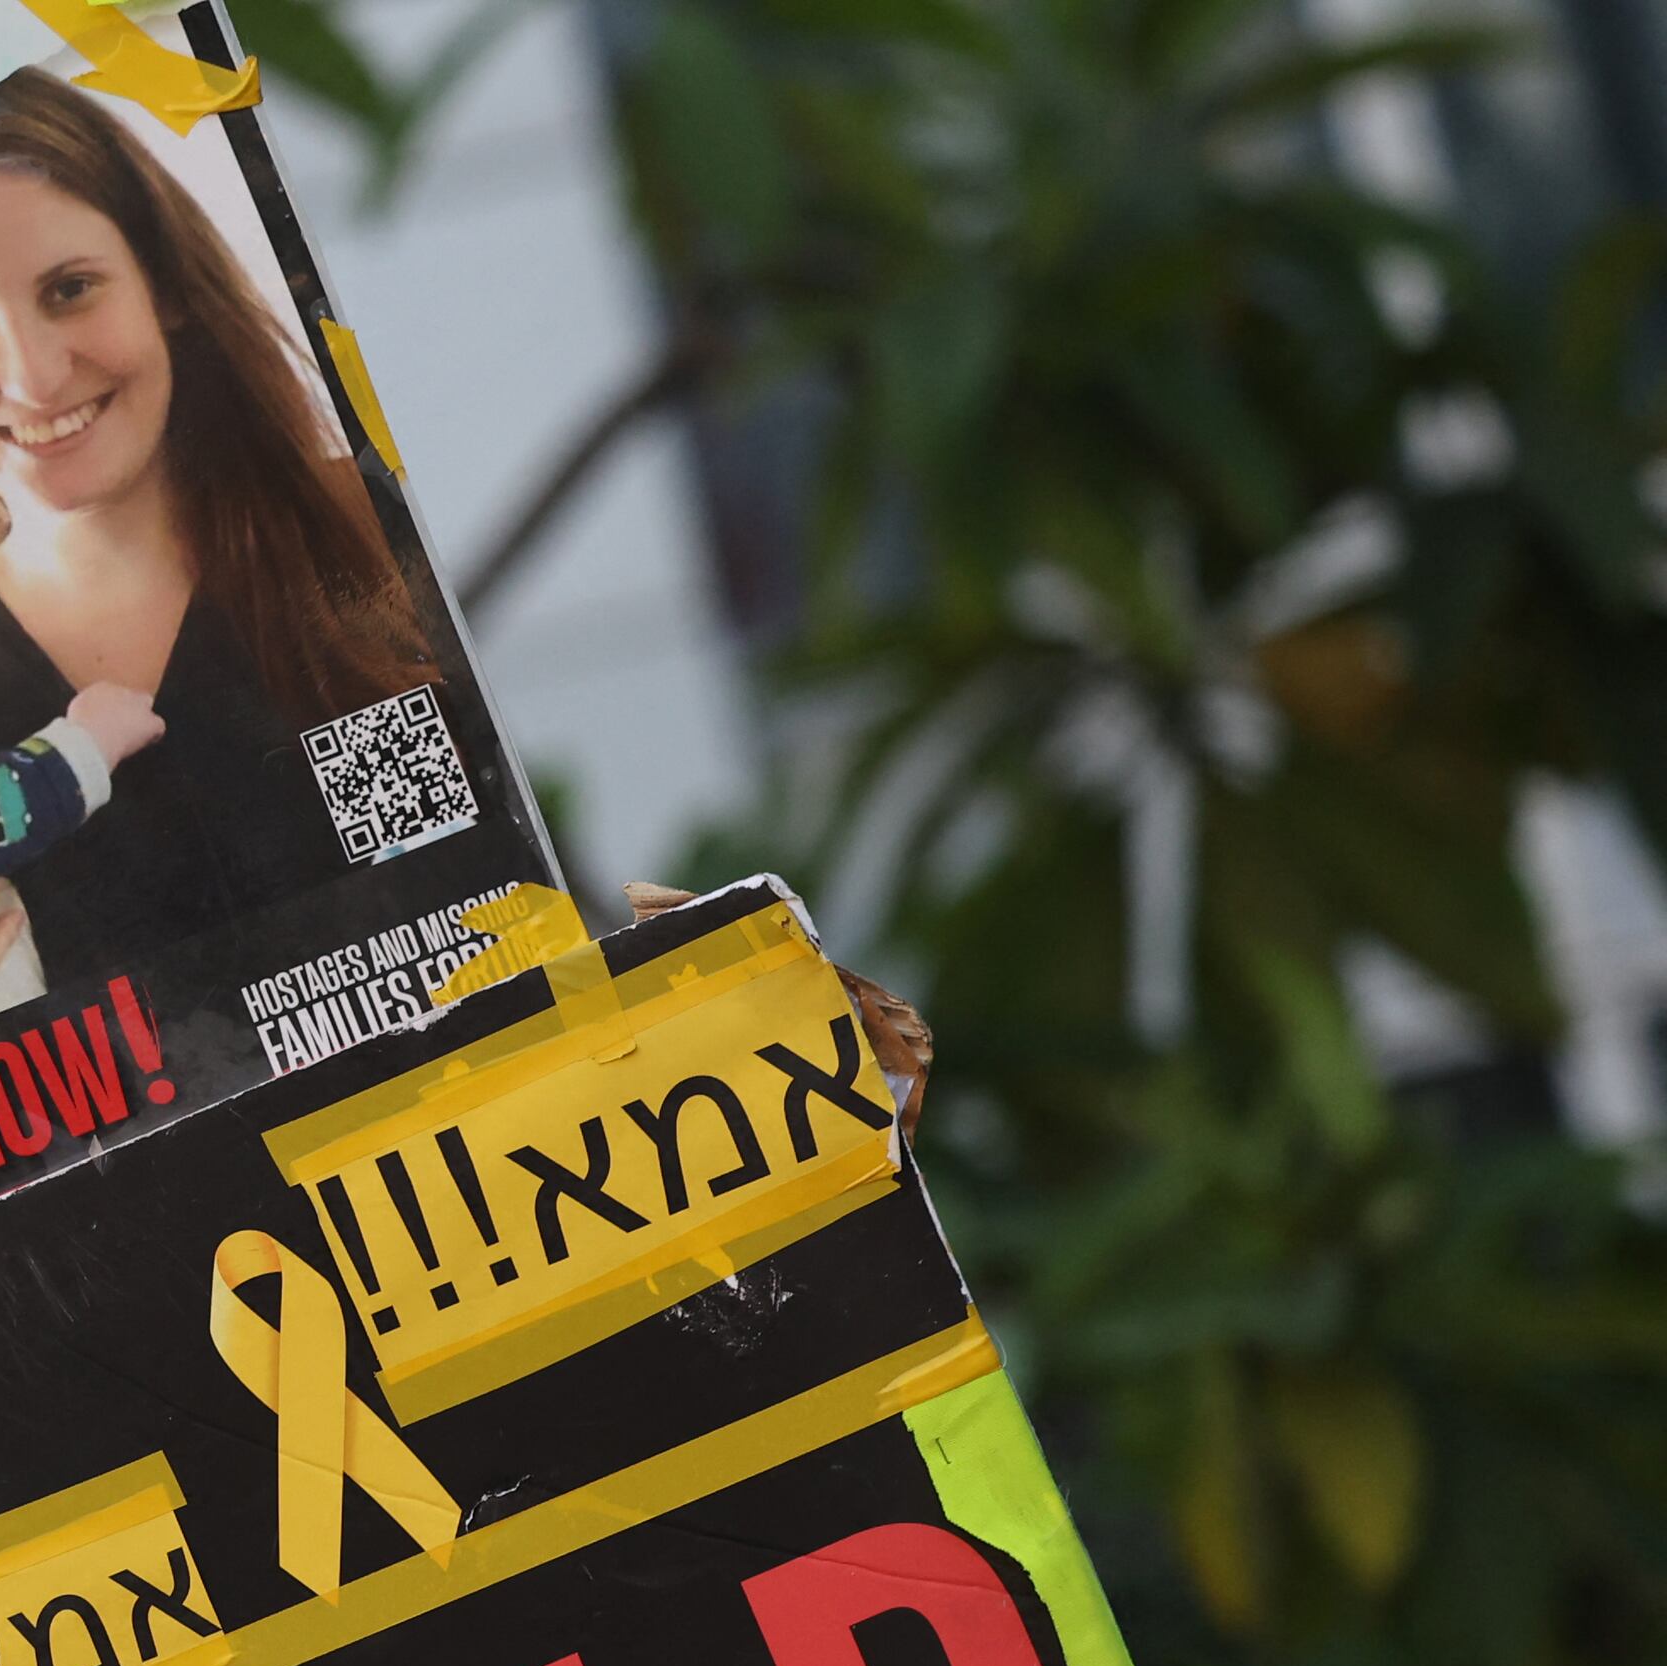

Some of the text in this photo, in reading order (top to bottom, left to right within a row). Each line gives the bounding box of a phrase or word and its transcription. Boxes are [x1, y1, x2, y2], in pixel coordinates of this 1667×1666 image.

[240, 943, 370, 1023] HOSTAGES
[366, 923, 421, 974] AND
[256, 969, 423, 1078] FAMILIES
[315, 1012, 895, 1336] אמא!!!
